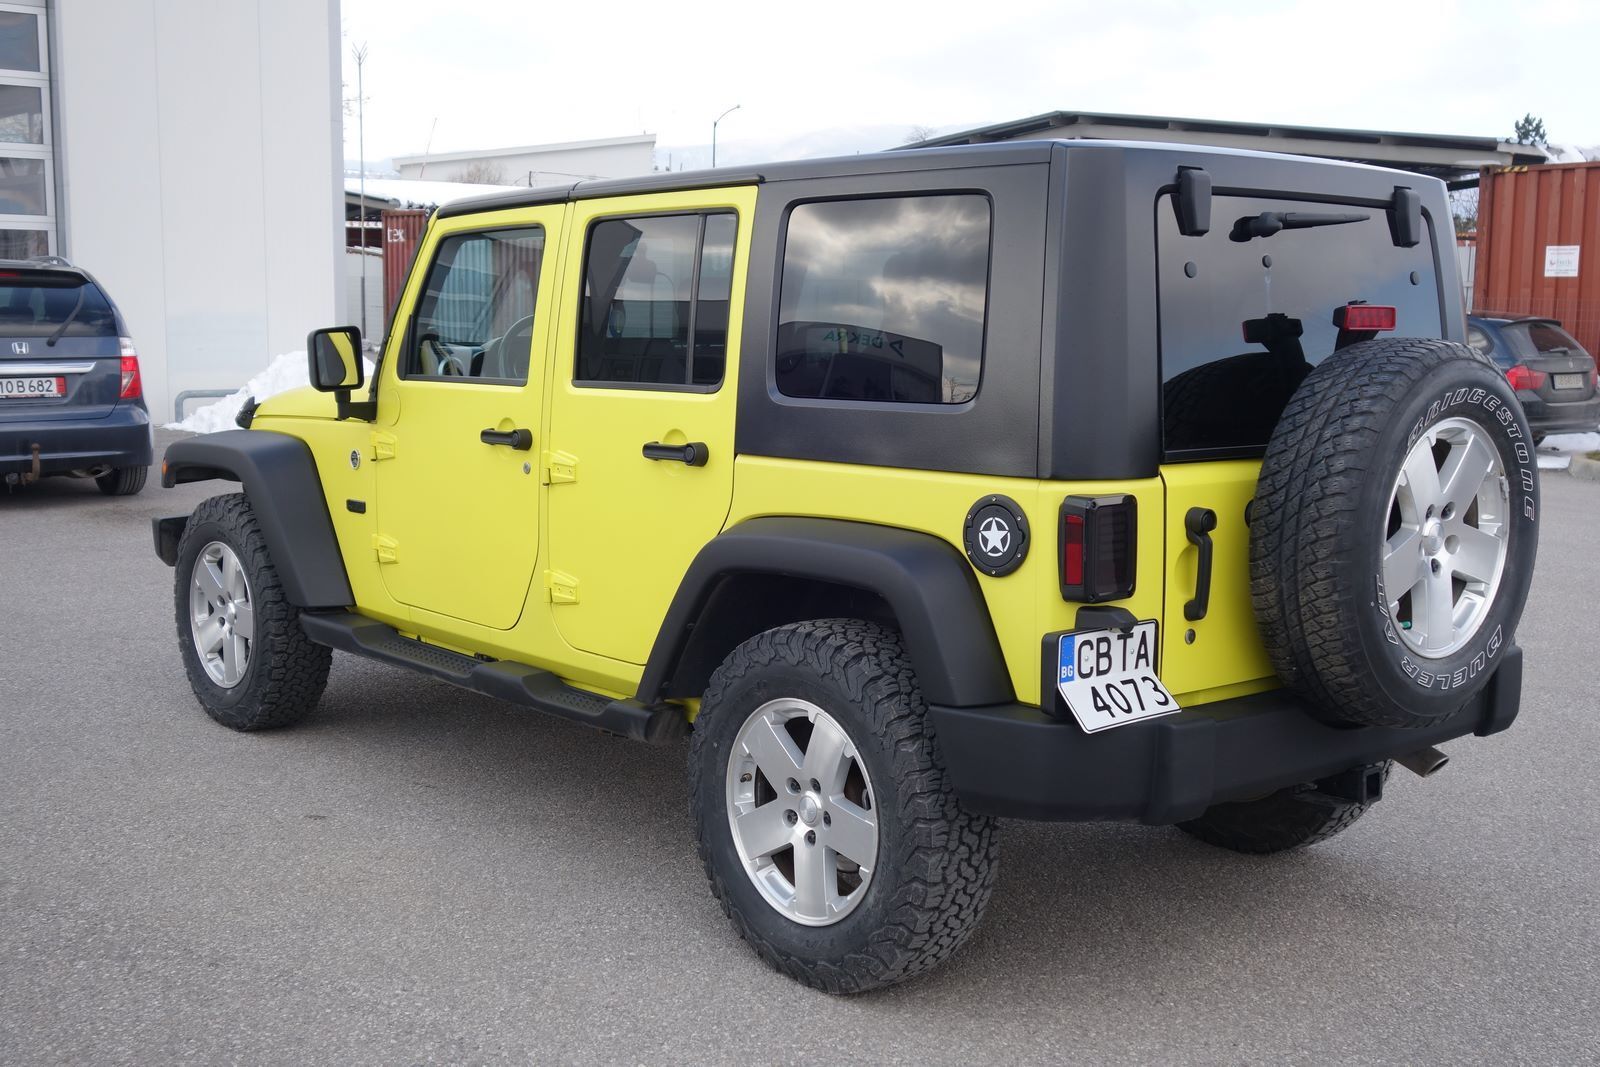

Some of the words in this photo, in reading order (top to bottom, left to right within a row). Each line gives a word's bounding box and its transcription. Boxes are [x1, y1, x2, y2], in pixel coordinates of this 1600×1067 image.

[1405, 387, 1535, 521] BRIDGESTONE
[1061, 665, 1074, 678] BG
[1401, 624, 1503, 689] DUELER
[1090, 676, 1170, 718] 4073
